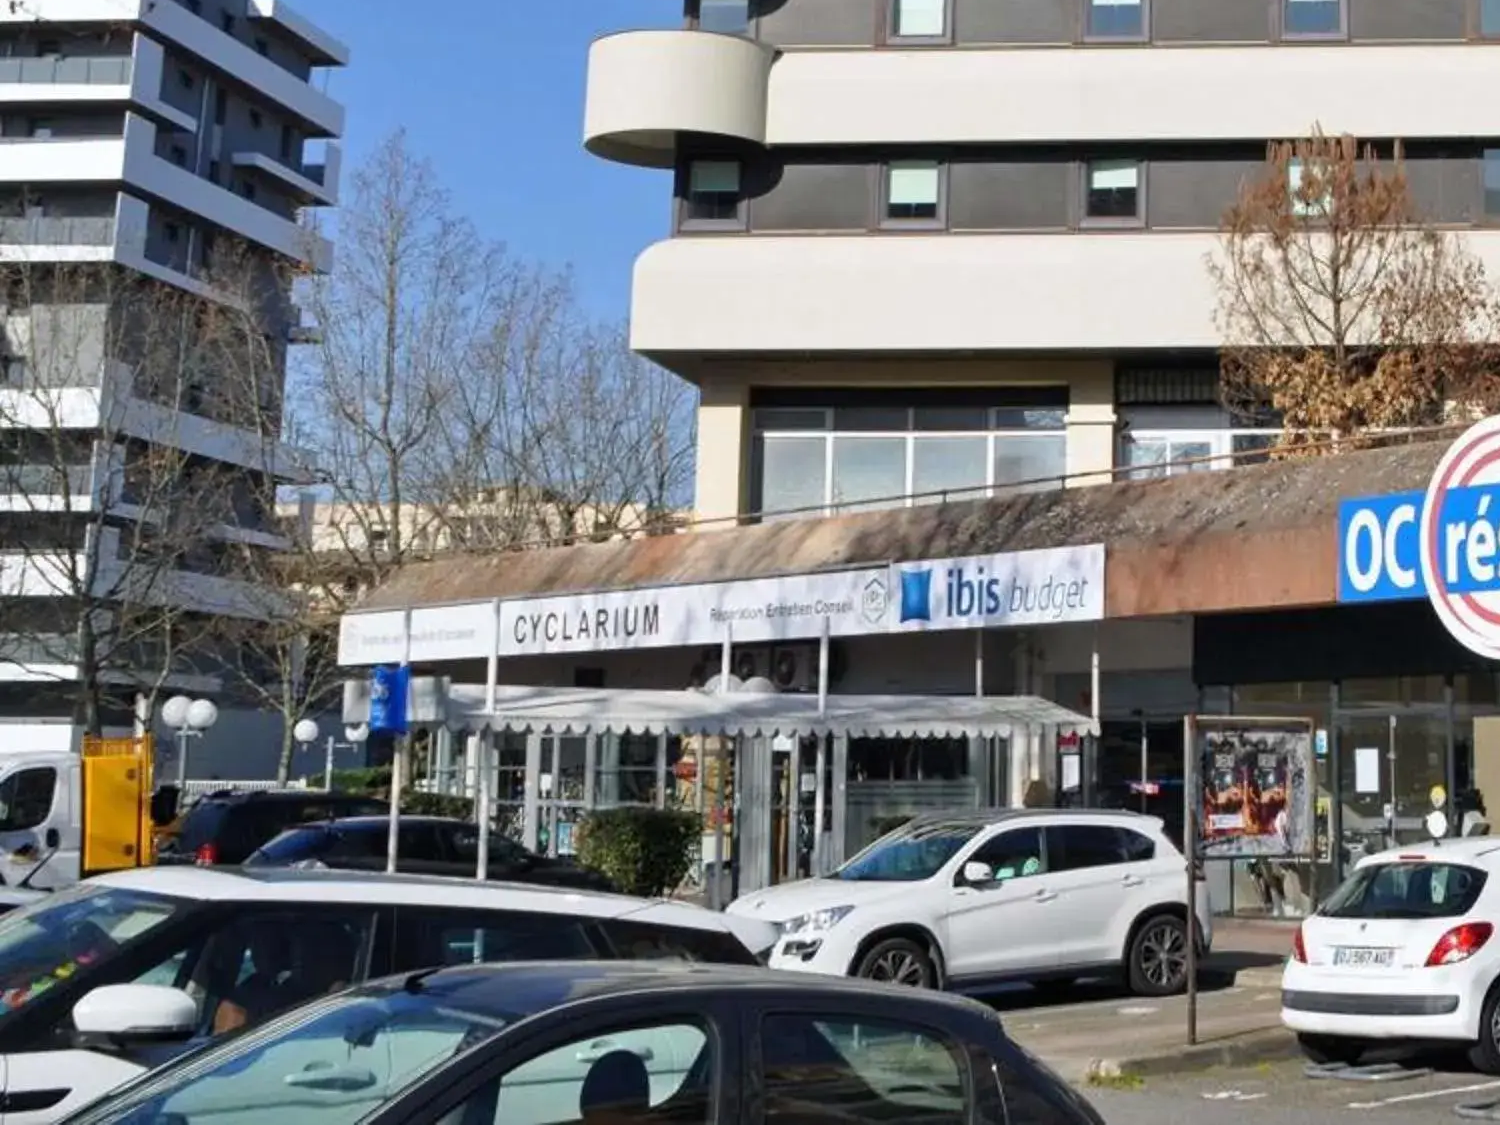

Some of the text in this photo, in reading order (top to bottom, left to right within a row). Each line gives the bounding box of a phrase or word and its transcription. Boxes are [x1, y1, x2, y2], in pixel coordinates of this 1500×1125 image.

[1345, 504, 1416, 592] OC
[946, 566, 1089, 619] ibis budget
[513, 604, 660, 644] CYCLARIUM
